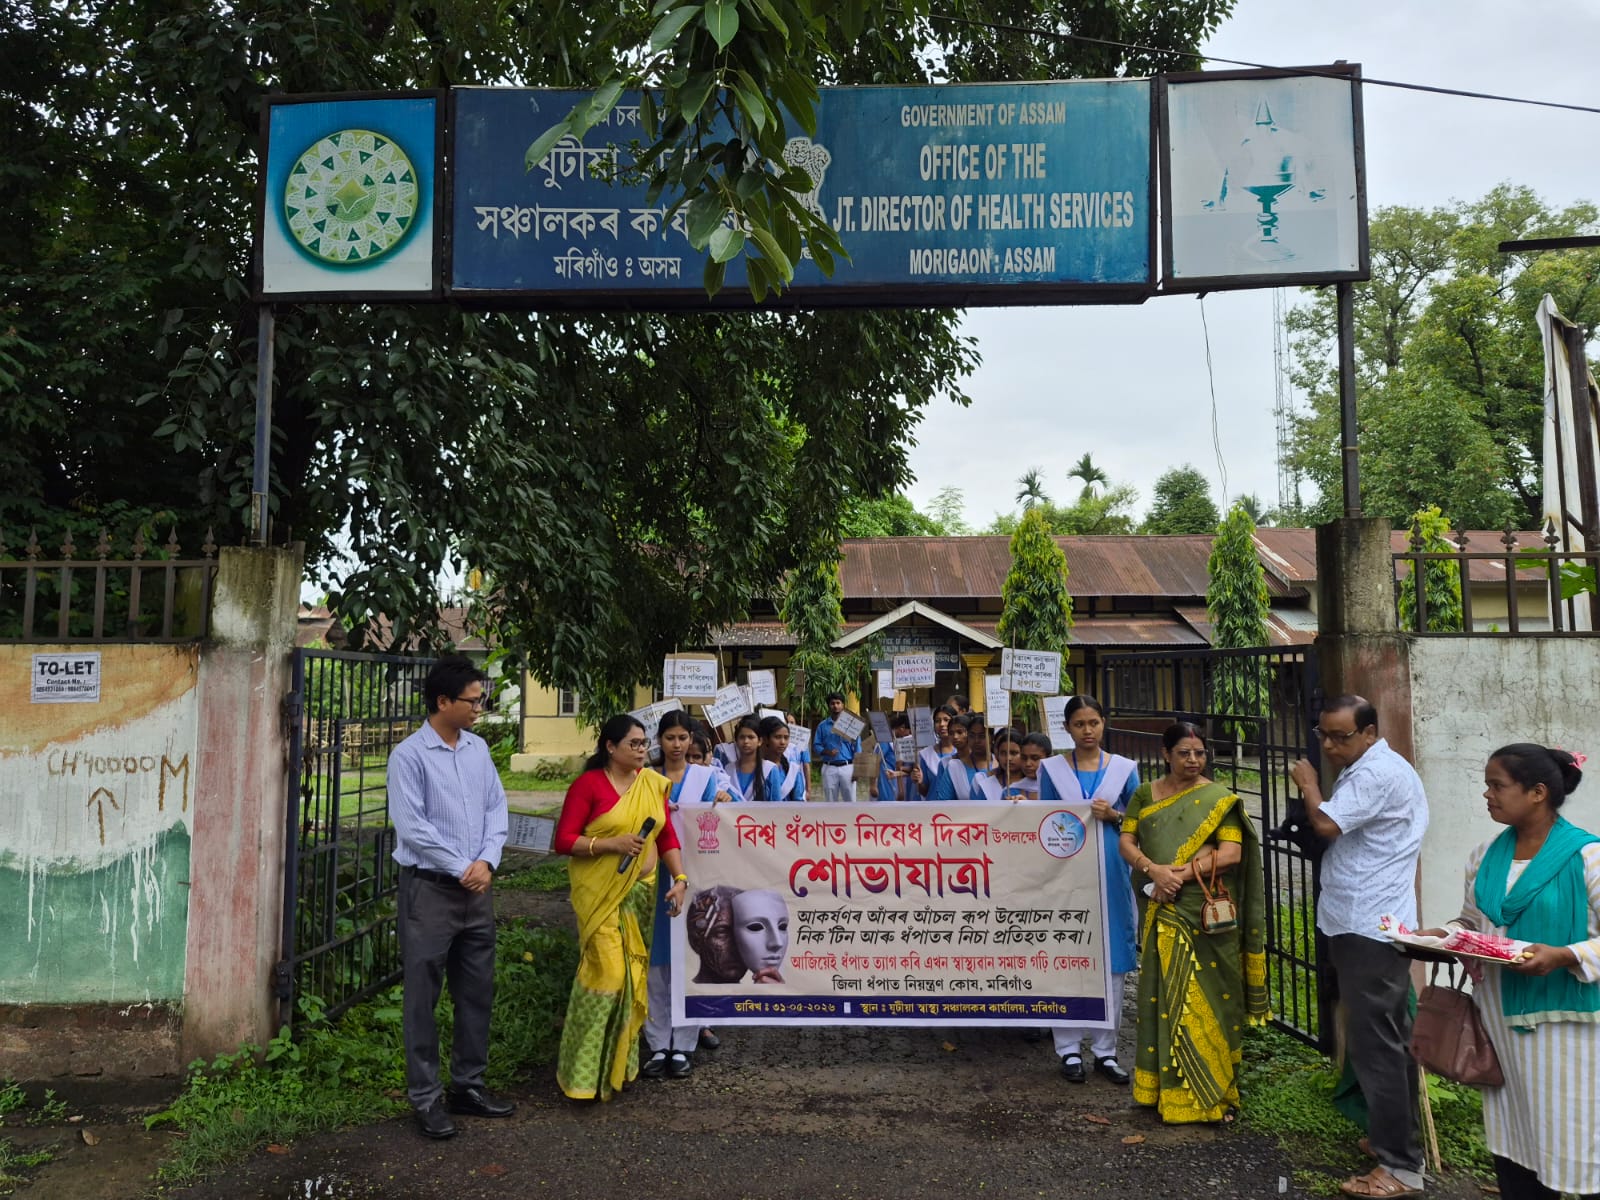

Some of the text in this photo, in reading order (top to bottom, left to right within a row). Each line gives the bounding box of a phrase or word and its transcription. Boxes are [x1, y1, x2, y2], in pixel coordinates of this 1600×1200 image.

[901, 101, 1066, 129] GOVERNMENT OF ASSAM
[919, 142, 1046, 182] OFFICE OF THE
[474, 202, 620, 240] সঞ্চালকৰ
[833, 190, 1135, 233] JT. DIRECTOR OF HEALTH SERVICES
[553, 247, 619, 279] মৰিগাঁও
[638, 256, 682, 279] অসম
[1003, 246, 1056, 274] ASSAM
[38, 661, 95, 675] TO-LET
[897, 658, 932, 666] TOBACCO
[734, 812, 776, 849] বিশ্ব
[785, 813, 848, 848] ধঁপাত
[855, 812, 922, 848] নিষেধ
[1058, 908, 1090, 925] কৰা
[859, 929, 896, 945] আৰু
[900, 925, 954, 945] ধঁপাতৰ
[958, 924, 990, 945] নিচা
[899, 951, 921, 971] কৰি
[924, 954, 949, 971] এখন
[997, 955, 1027, 971] সমাজ
[832, 974, 863, 992] জিলা
[866, 974, 901, 992] ধঁপাত
[987, 974, 1033, 992] মৰিগাঁও
[734, 999, 763, 1013] তাৰিখ
